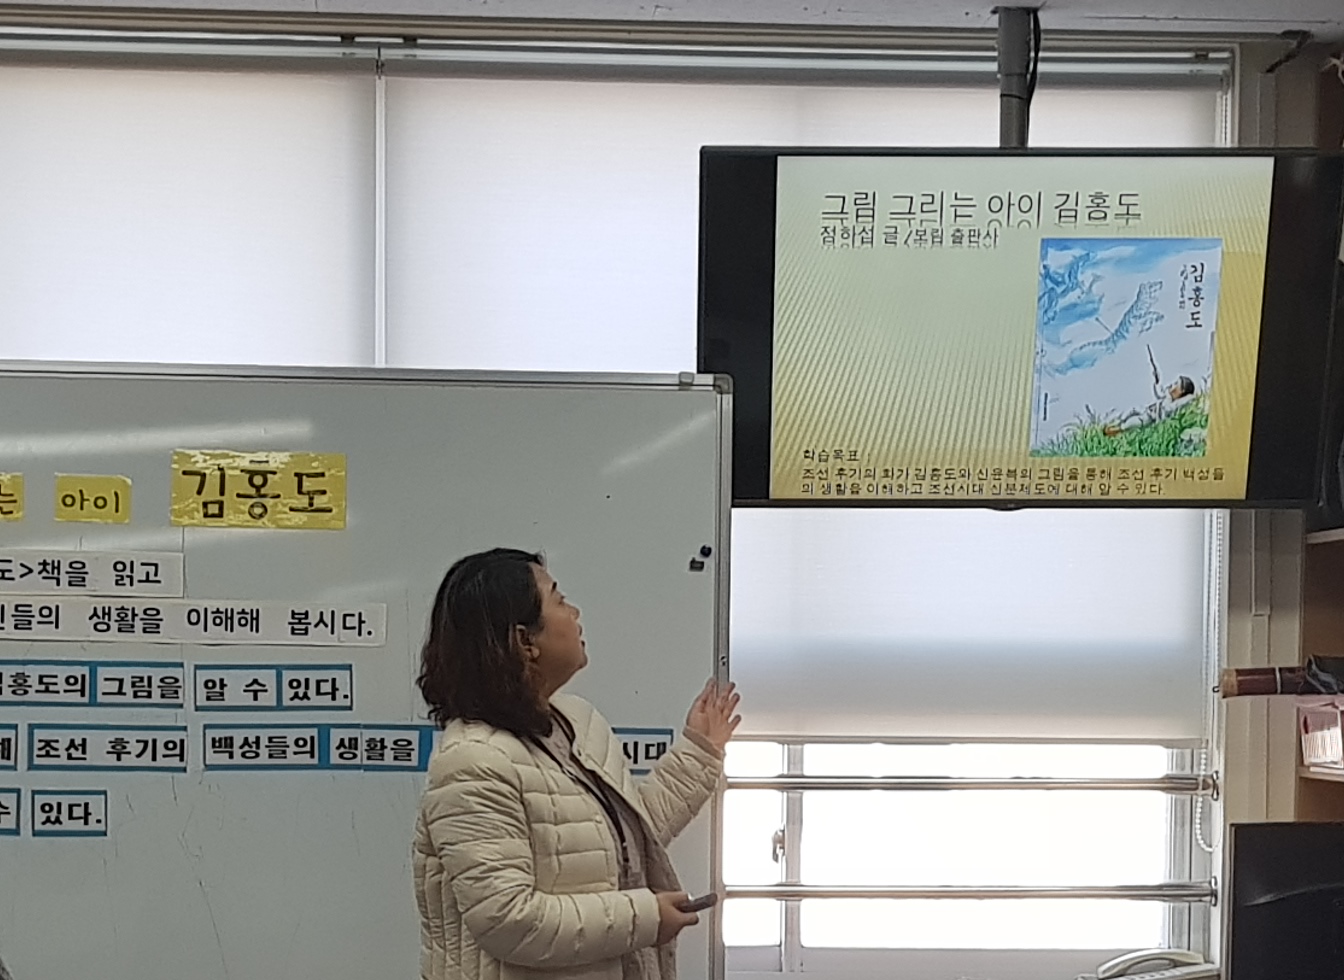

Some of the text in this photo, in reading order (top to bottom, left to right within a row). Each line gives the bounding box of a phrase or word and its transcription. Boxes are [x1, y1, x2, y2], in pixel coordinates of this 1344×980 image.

[821, 190, 1142, 228] 그림 그리는 아이 김홍도
[883, 225, 899, 246] 글
[950, 228, 999, 249] 출판사
[1185, 262, 1205, 329] 김홍도
[802, 449, 860, 463] 학습목표
[802, 467, 829, 481] 조선
[834, 467, 876, 481] 후기의
[881, 467, 910, 481] 화가
[914, 467, 971, 481] 김홍도와
[1037, 467, 1079, 481] 그림을
[1085, 467, 1111, 481] 통해
[1117, 467, 1145, 481] 조선
[1149, 467, 1177, 481] 후기
[1183, 467, 1225, 481] 백성들
[61, 489, 119, 514] 아이
[182, 459, 333, 520] 김홍도
[801, 483, 814, 496] 의
[821, 482, 862, 496] 생활을
[866, 482, 923, 496] 이해하고
[991, 482, 1060, 496] 신분제도에
[1065, 482, 1092, 496] 대해
[1098, 482, 1111, 496] 알
[1116, 483, 1130, 495] 수
[112, 559, 162, 587] 읽고
[88, 605, 164, 635] 생활을
[187, 606, 260, 634] 이해해
[287, 608, 373, 637] 봅시다.
[101, 675, 182, 699] 그림을
[203, 677, 228, 702] 알
[242, 678, 269, 702] 수
[288, 677, 349, 702] 있다.
[35, 737, 88, 761] 조선
[106, 736, 185, 762] 후기의
[211, 735, 316, 760] 백성들의
[335, 735, 415, 762] 생활을
[39, 801, 102, 826] 있다.
